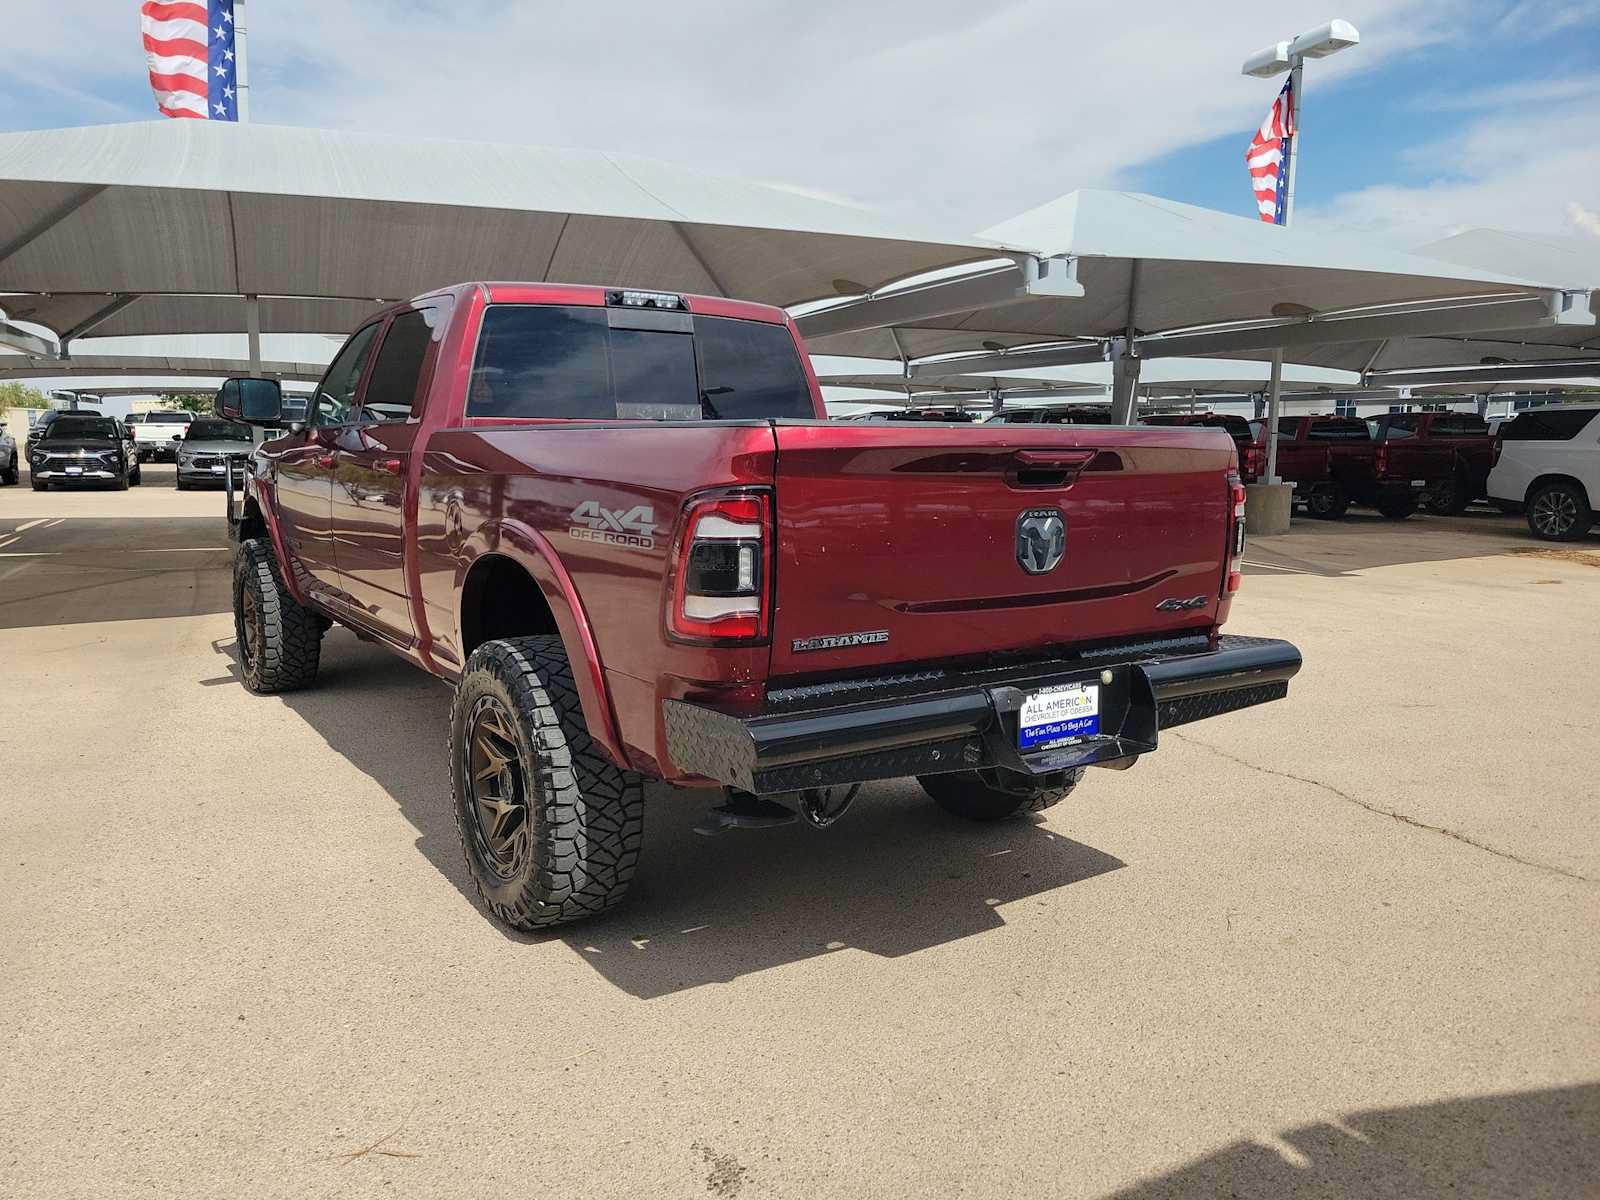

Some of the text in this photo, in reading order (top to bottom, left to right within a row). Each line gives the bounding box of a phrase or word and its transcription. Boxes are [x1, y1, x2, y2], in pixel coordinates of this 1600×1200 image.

[570, 528, 652, 548] OFF ROAD
[792, 630, 889, 651] LARAMIE
[1026, 696, 1091, 714] ALL AMERICAN
[1024, 711, 1060, 723] CHEVROLET
[1061, 708, 1069, 717] OF
